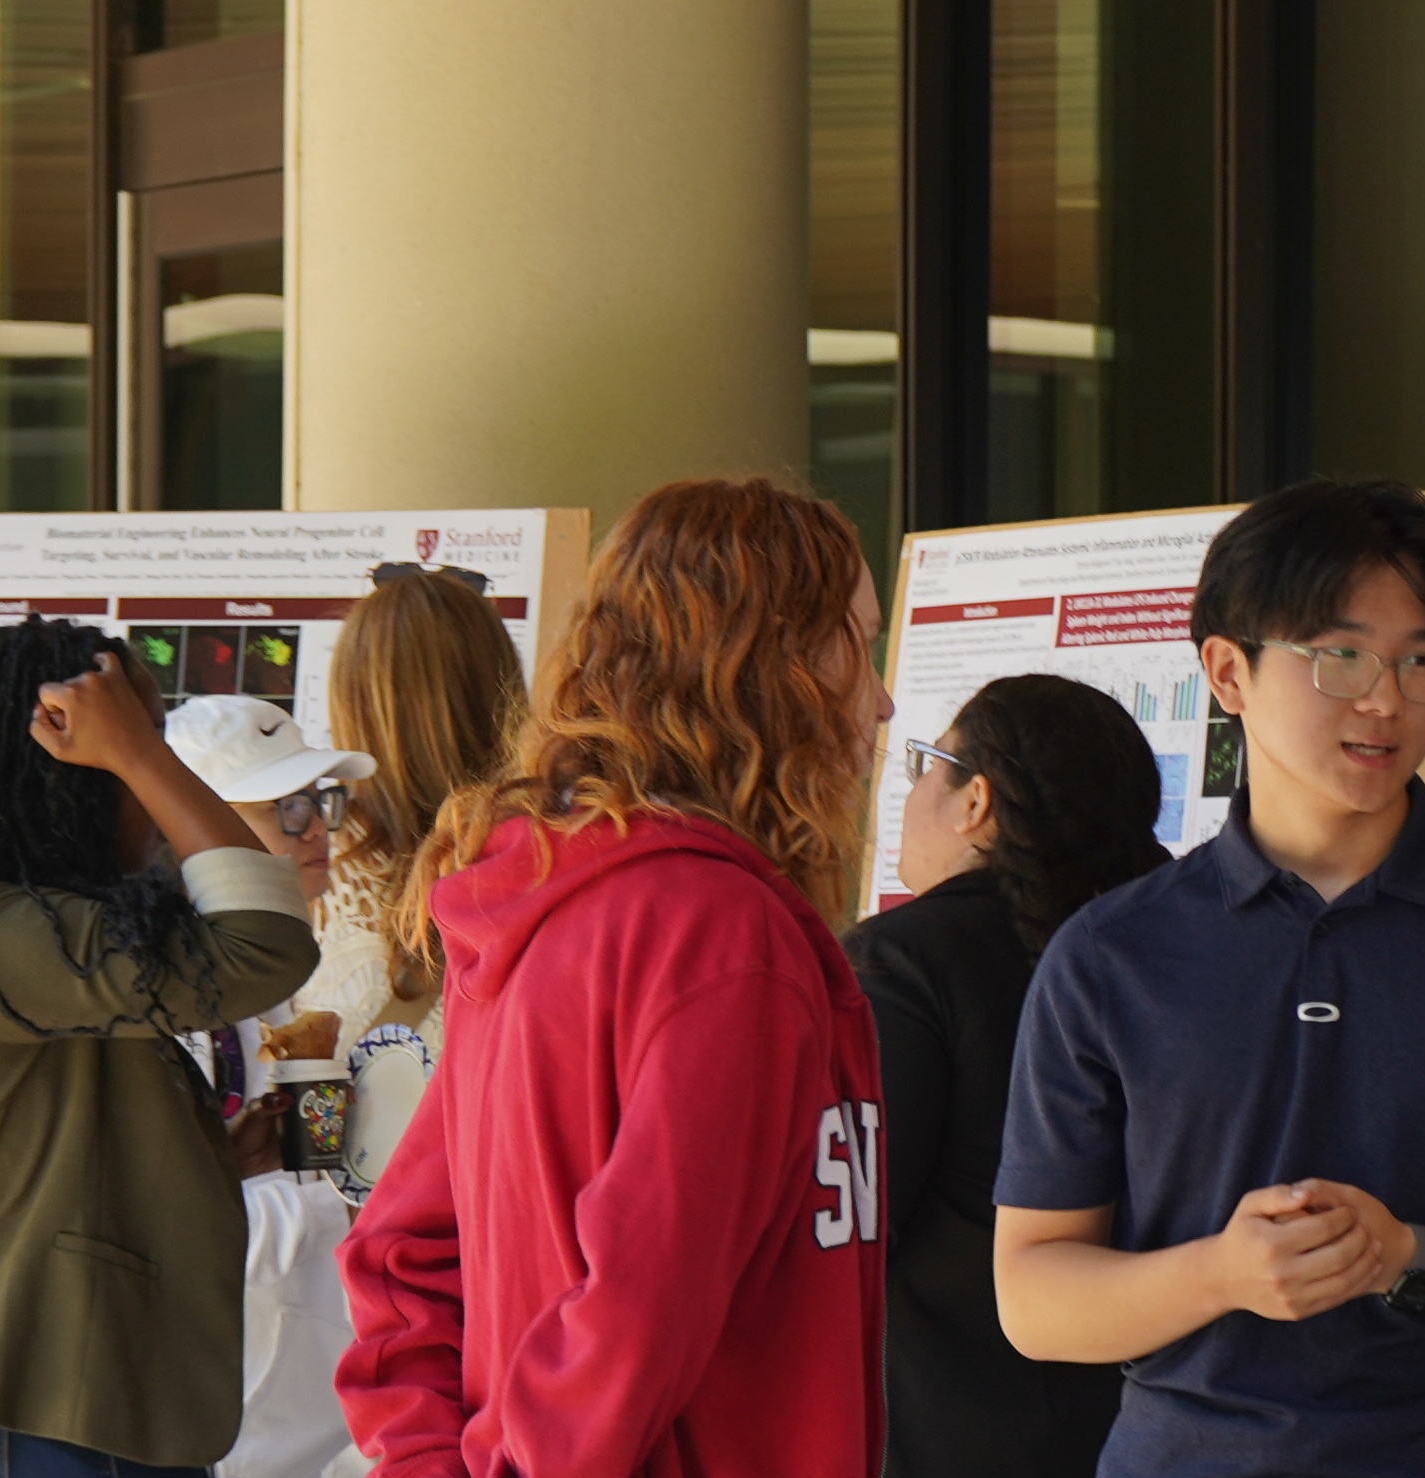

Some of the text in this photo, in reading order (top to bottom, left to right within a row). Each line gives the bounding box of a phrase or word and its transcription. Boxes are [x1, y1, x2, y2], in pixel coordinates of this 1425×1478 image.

[117, 527, 186, 541] Engineering
[191, 526, 246, 538] Enhances
[251, 526, 289, 538] Neural
[293, 525, 356, 540] Progenitor
[360, 525, 384, 538] Cell
[444, 526, 523, 546] Stanford
[102, 549, 152, 562] Survival,
[158, 550, 179, 560] and
[184, 549, 232, 560] Vascular
[238, 549, 306, 563] Remodeling
[313, 548, 341, 560] After
[346, 548, 384, 560] Stroke
[444, 551, 520, 562] MEDICINE
[225, 601, 273, 617] Results
